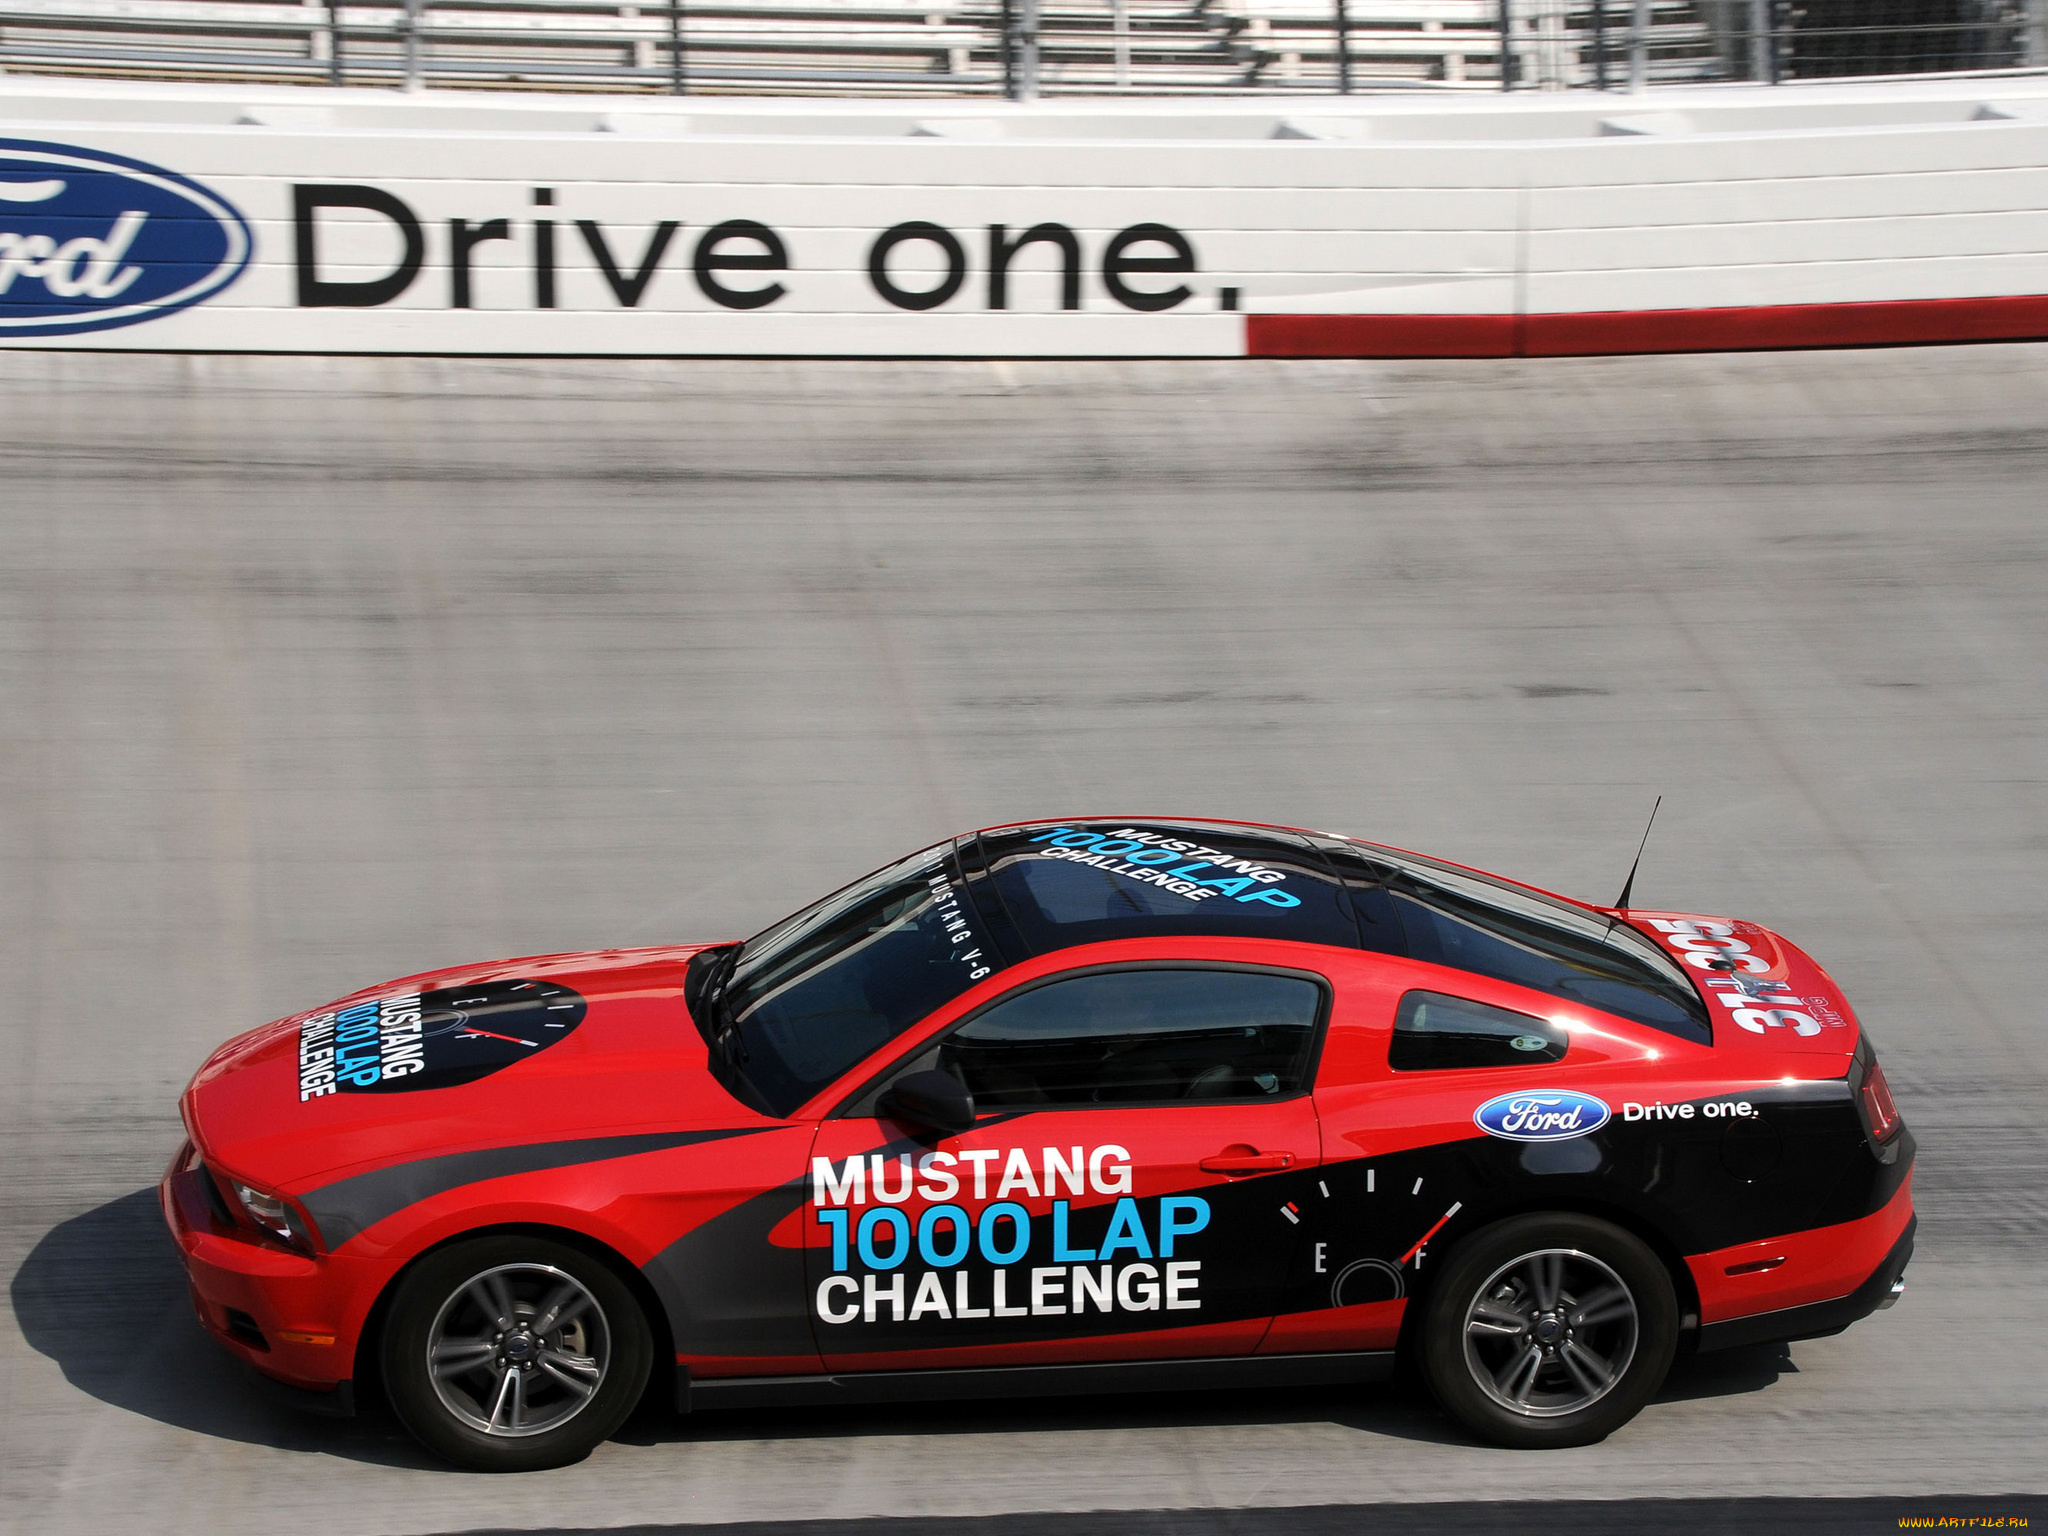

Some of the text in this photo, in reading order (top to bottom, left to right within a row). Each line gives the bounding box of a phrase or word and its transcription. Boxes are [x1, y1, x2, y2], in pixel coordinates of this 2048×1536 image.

[290, 183, 1243, 311] Drive one.
[1028, 827, 1301, 908] 1000 LAP
[1040, 847, 1219, 901] CHALLENGE
[1106, 828, 1287, 884] MUSTANG
[928, 873, 972, 944] MUSTANG
[961, 948, 990, 980] V-6
[335, 1000, 381, 1086] 1000 LAP
[380, 992, 425, 1080] MUSTANG
[1716, 993, 1822, 1037] 31
[300, 1012, 337, 1102] CHALLENGE
[1502, 1097, 1583, 1132] Ford
[1623, 1100, 1759, 1122] Drive one.
[812, 1144, 1133, 1206] MUSTANG
[818, 1195, 1212, 1272] 1000 LAP
[1315, 1242, 1328, 1273] E
[1415, 1241, 1428, 1270] F
[816, 1260, 1202, 1325] CHALLENGE
